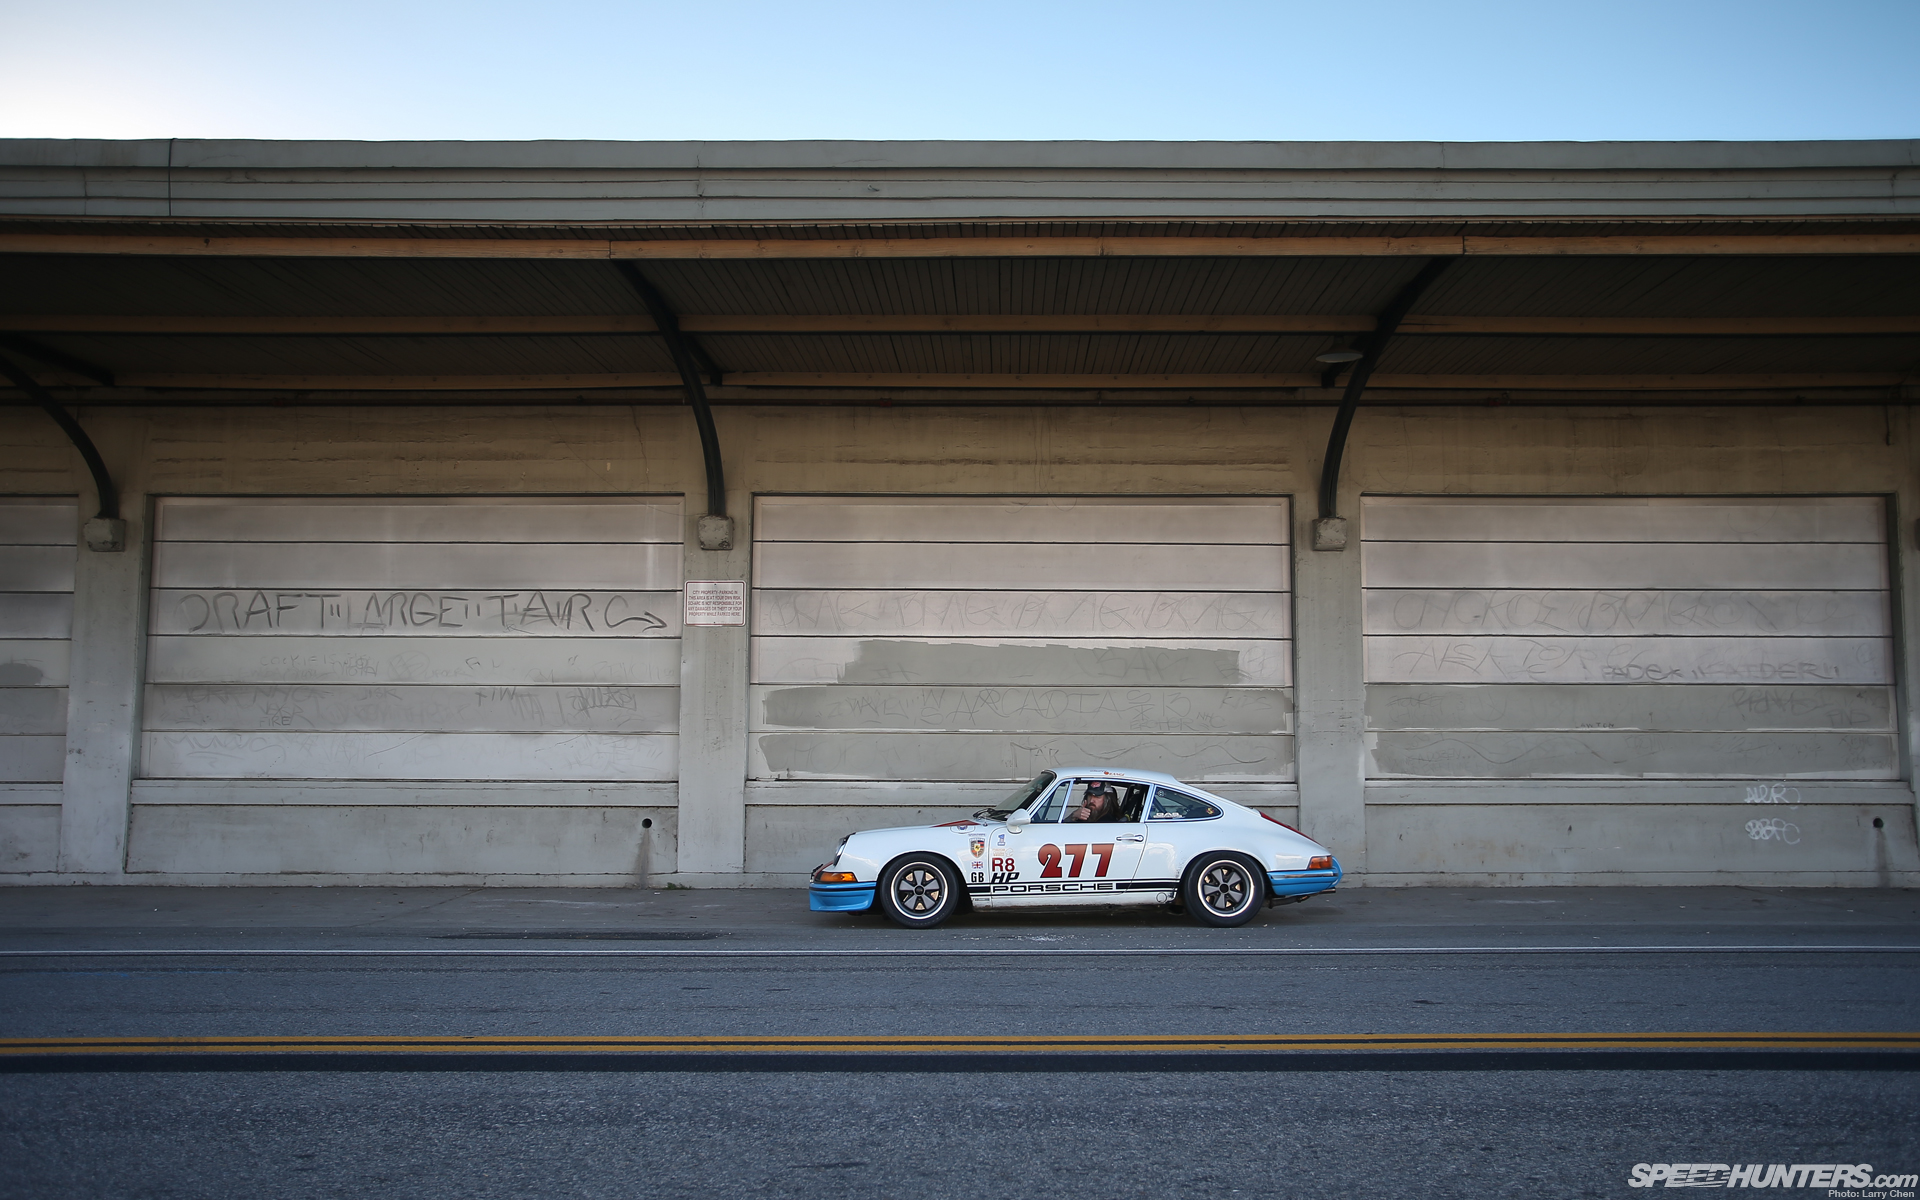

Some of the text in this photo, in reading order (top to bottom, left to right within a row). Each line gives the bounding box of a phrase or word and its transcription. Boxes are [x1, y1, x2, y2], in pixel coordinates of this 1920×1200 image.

[992, 857, 1015, 872] R8
[1037, 843, 1115, 879] 277
[971, 872, 985, 883] GB
[991, 872, 1020, 884] HP
[992, 883, 1114, 893] PORSCHE
